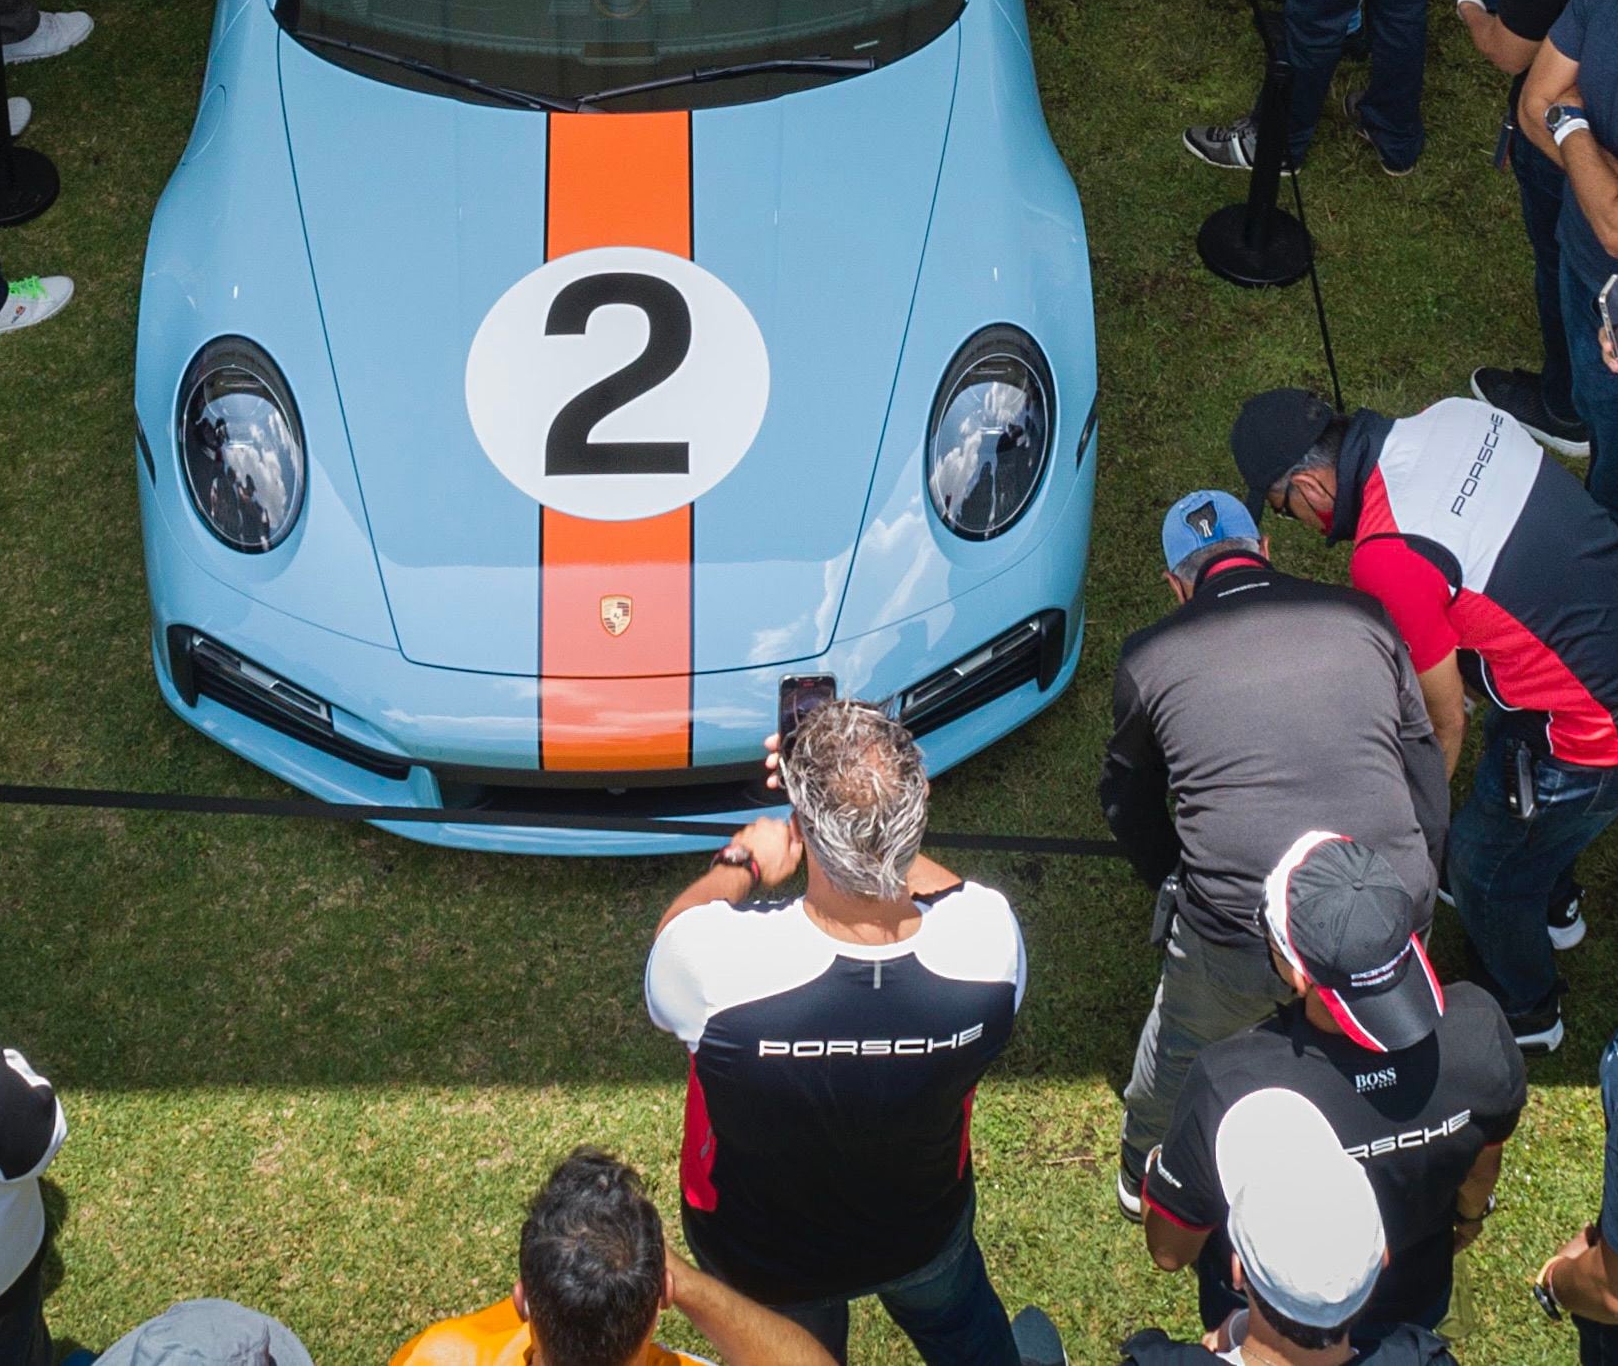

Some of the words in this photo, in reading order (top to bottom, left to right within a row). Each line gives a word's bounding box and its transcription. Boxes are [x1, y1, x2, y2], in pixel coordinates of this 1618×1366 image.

[544, 272, 692, 476] 2
[1451, 413, 1503, 518] PORSCHE
[758, 1022, 985, 1059] PORSCHE
[1355, 1066, 1397, 1089] BOSS
[1345, 1109, 1471, 1160] RSCHE
